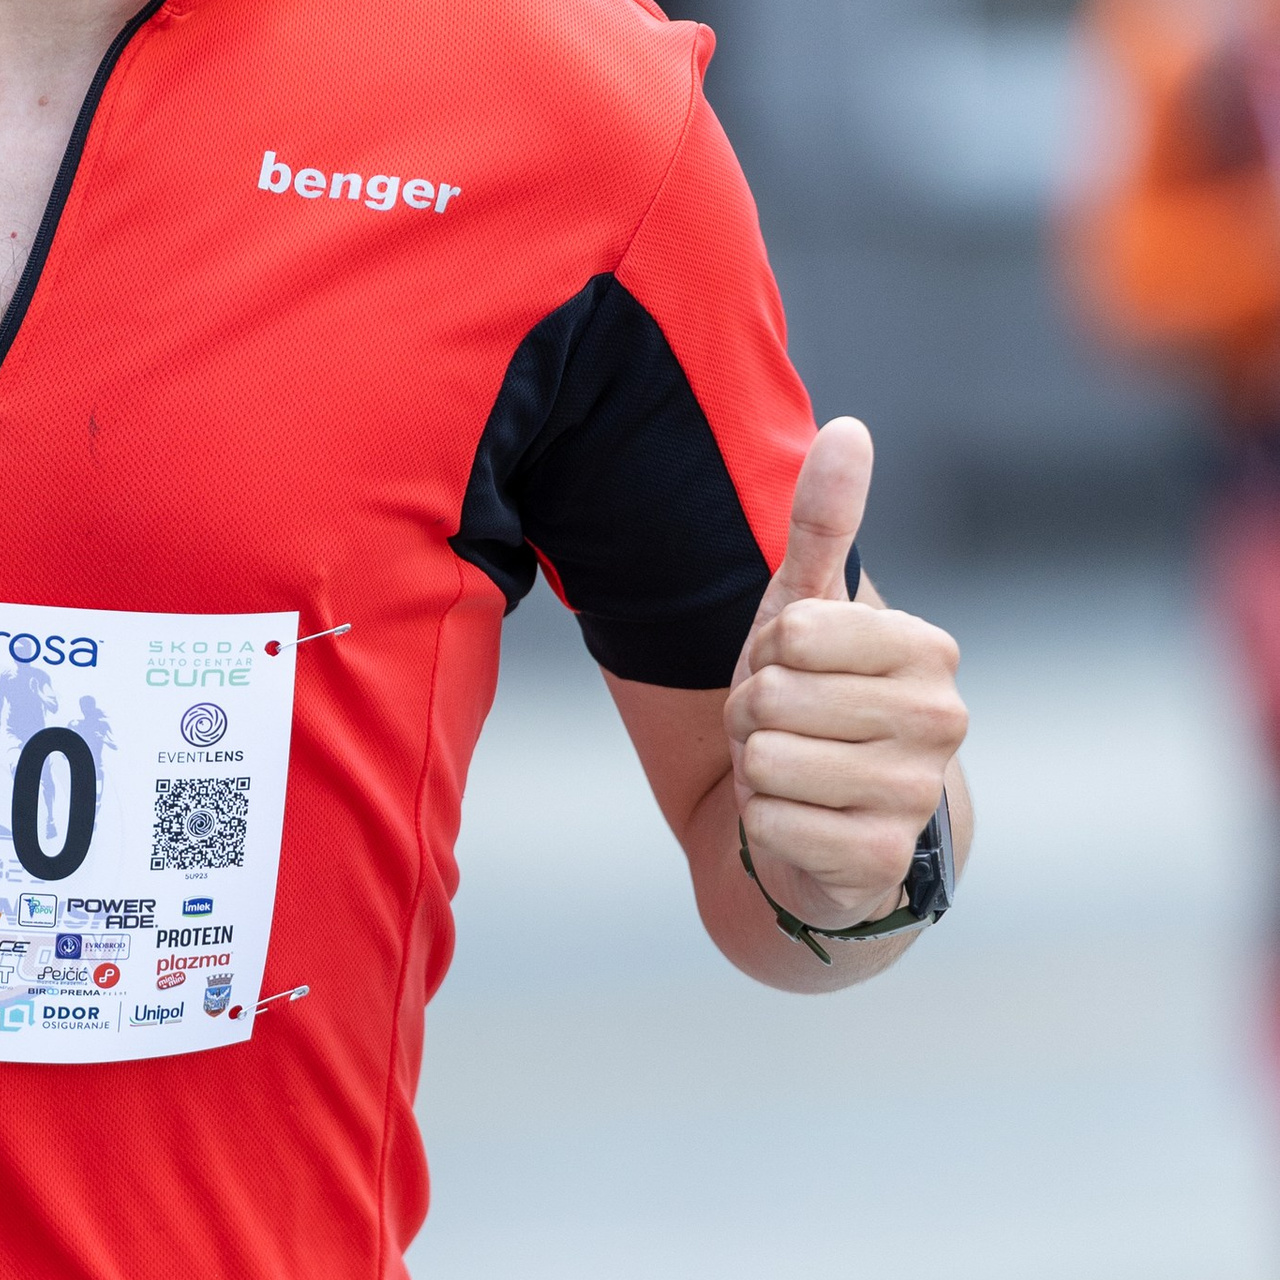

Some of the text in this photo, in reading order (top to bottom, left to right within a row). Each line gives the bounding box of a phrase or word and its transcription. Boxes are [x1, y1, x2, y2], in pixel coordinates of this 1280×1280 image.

[257, 150, 462, 214] benger
[147, 657, 253, 668] AUTO CENTAR
[145, 668, 252, 688] CUNE
[157, 750, 244, 764] EVENTLENS
[67, 898, 157, 914] POWER
[184, 900, 212, 913] imlek
[156, 925, 234, 948] PROTEIN
[157, 953, 231, 976] plazma
[37, 966, 88, 981] Pejčić
[43, 1006, 100, 1019] DDOR
[134, 1001, 184, 1025] Unipol
[42, 1021, 110, 1030] OSIGURANJE
